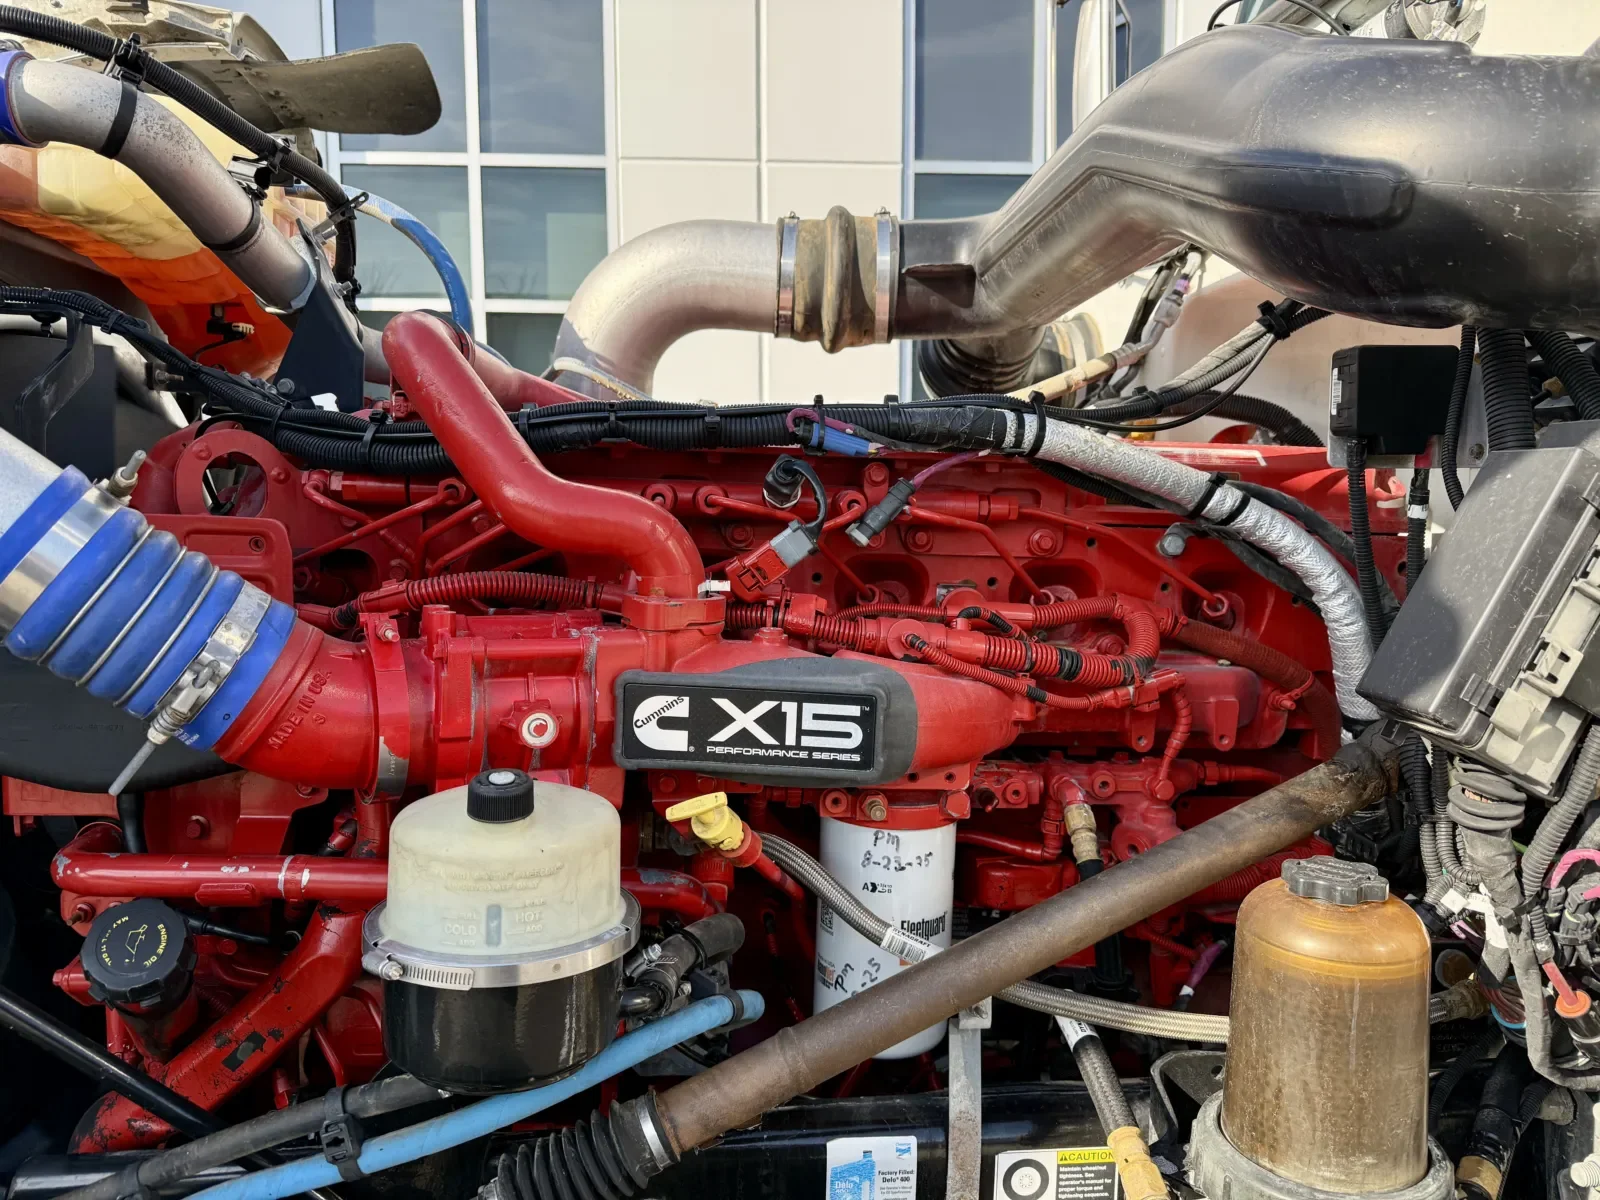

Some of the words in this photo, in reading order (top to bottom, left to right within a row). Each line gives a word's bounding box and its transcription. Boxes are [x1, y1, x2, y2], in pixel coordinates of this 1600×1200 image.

[268, 712, 304, 749] MADE
[297, 695, 315, 714] IN
[633, 695, 684, 729] Cummins
[707, 697, 863, 749] X15
[707, 746, 808, 758] PERFORMANCE
[812, 751, 861, 762] SERIES
[157, 923, 168, 955] ENGINE
[444, 923, 477, 936] COLD
[901, 912, 946, 941] Fleetguard
